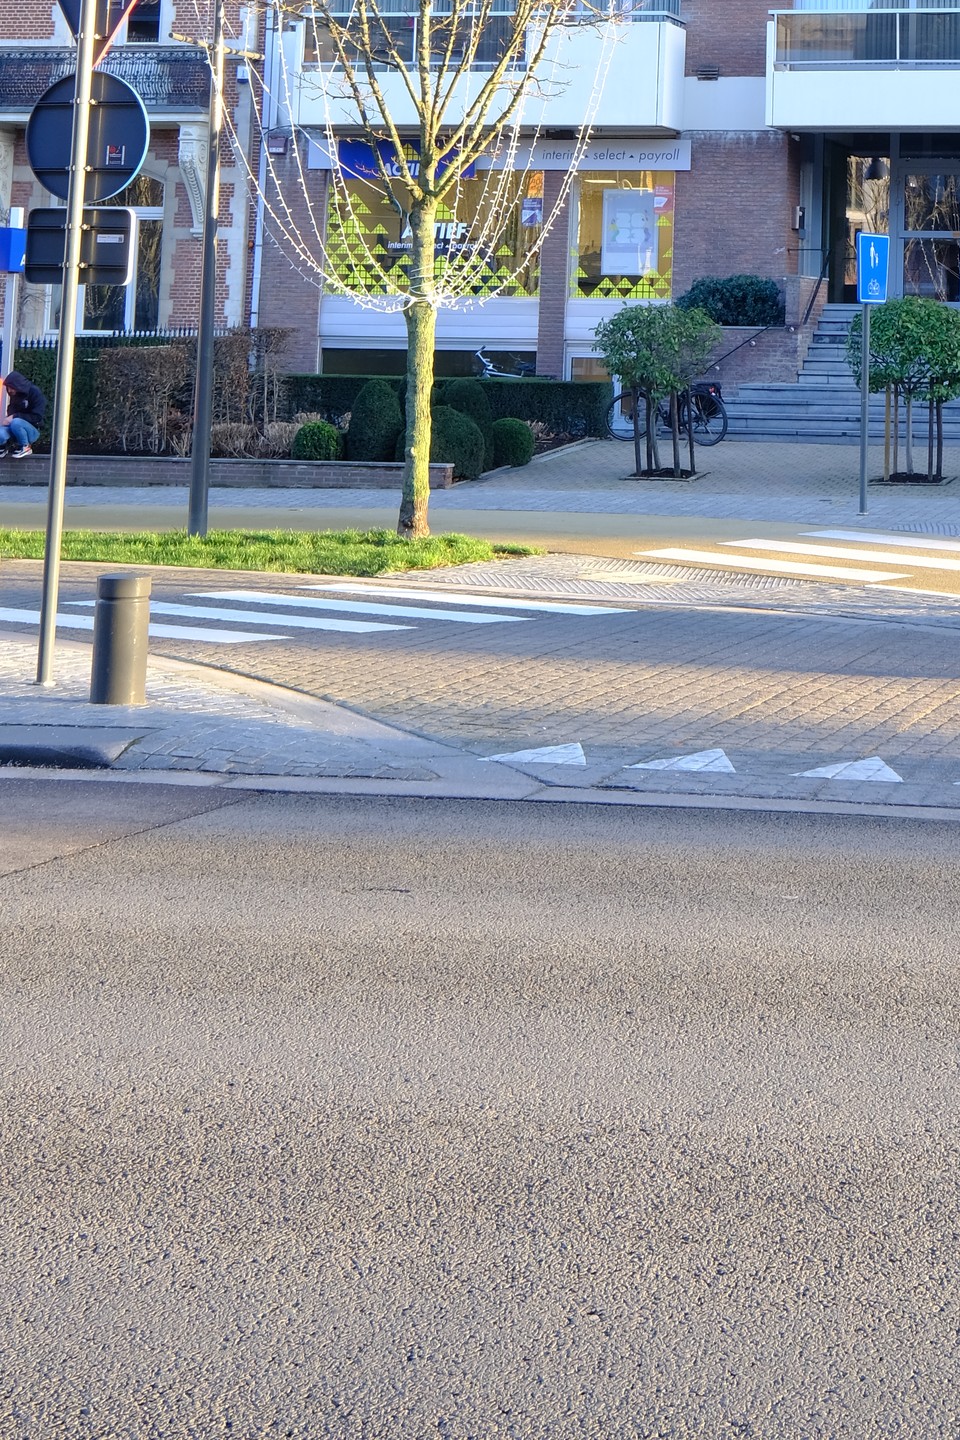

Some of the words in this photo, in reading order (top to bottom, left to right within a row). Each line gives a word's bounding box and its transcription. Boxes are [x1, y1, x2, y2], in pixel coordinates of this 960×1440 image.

[593, 148, 626, 161] select
[639, 148, 680, 163] payroll
[384, 162, 421, 176] ACTI
[401, 222, 468, 240] ATIEF
